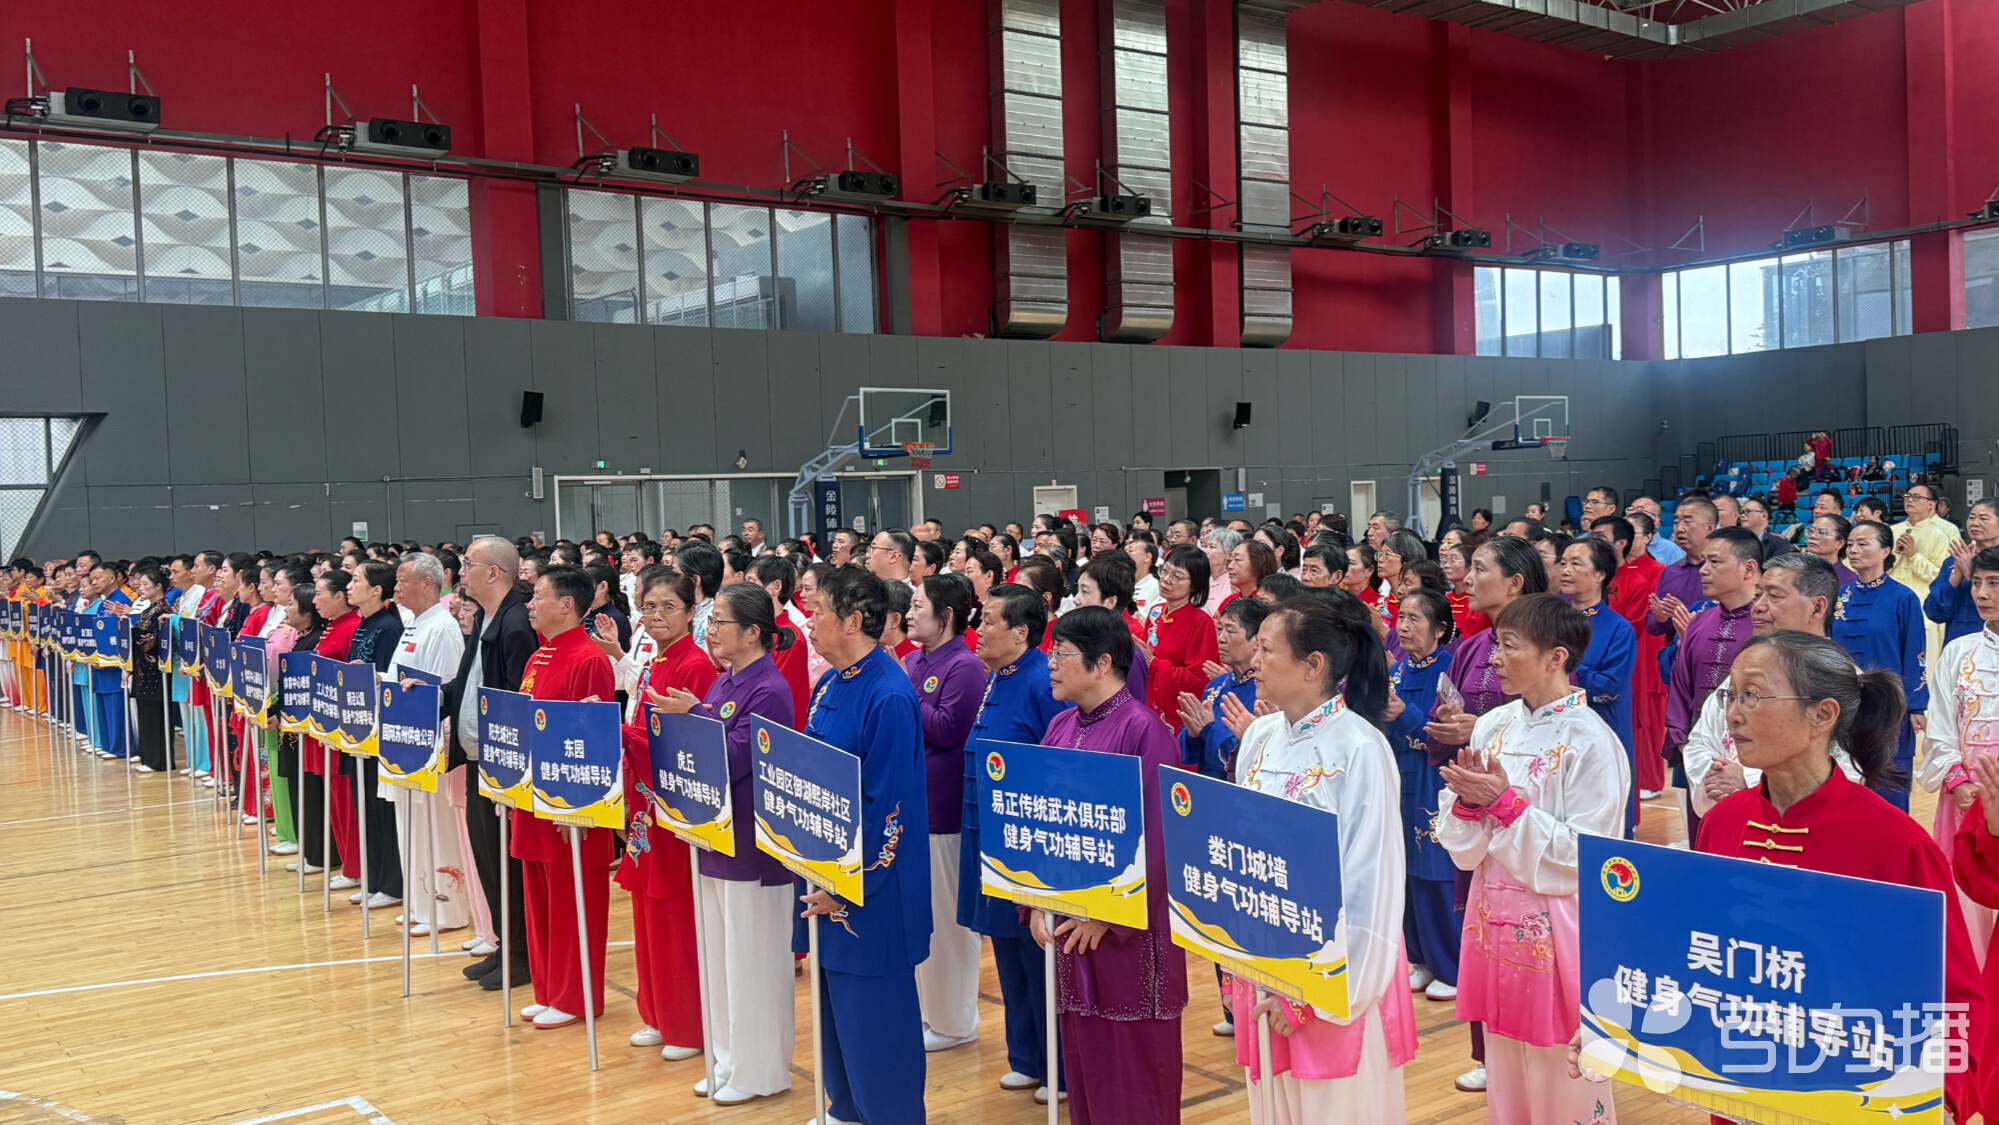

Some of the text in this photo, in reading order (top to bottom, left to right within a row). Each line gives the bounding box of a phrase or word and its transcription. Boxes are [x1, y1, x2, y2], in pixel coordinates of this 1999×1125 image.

[382, 723, 435, 748] 国网苏州供电公司
[488, 722, 519, 747] 阳光城社区
[564, 738, 585, 759] 东园
[483, 744, 526, 772] 健身气功辅导站
[541, 761, 612, 787] 健身气功辅导站
[677, 750, 696, 774] 虎丘
[659, 769, 721, 809] 健身气功辅导站
[759, 760, 851, 823] 工业园区御湖熙岸社区
[991, 789, 1126, 834] 易正传统武术俱乐部
[763, 789, 848, 851] 健身气功辅导站
[1003, 823, 1116, 868] 健身气功辅导站
[1208, 835, 1289, 891] 娄门城墙
[1183, 863, 1324, 944] 健身气功辅导站
[1687, 930, 1806, 994] 吴门桥
[1614, 965, 1895, 1073] 健身气功辅导站
